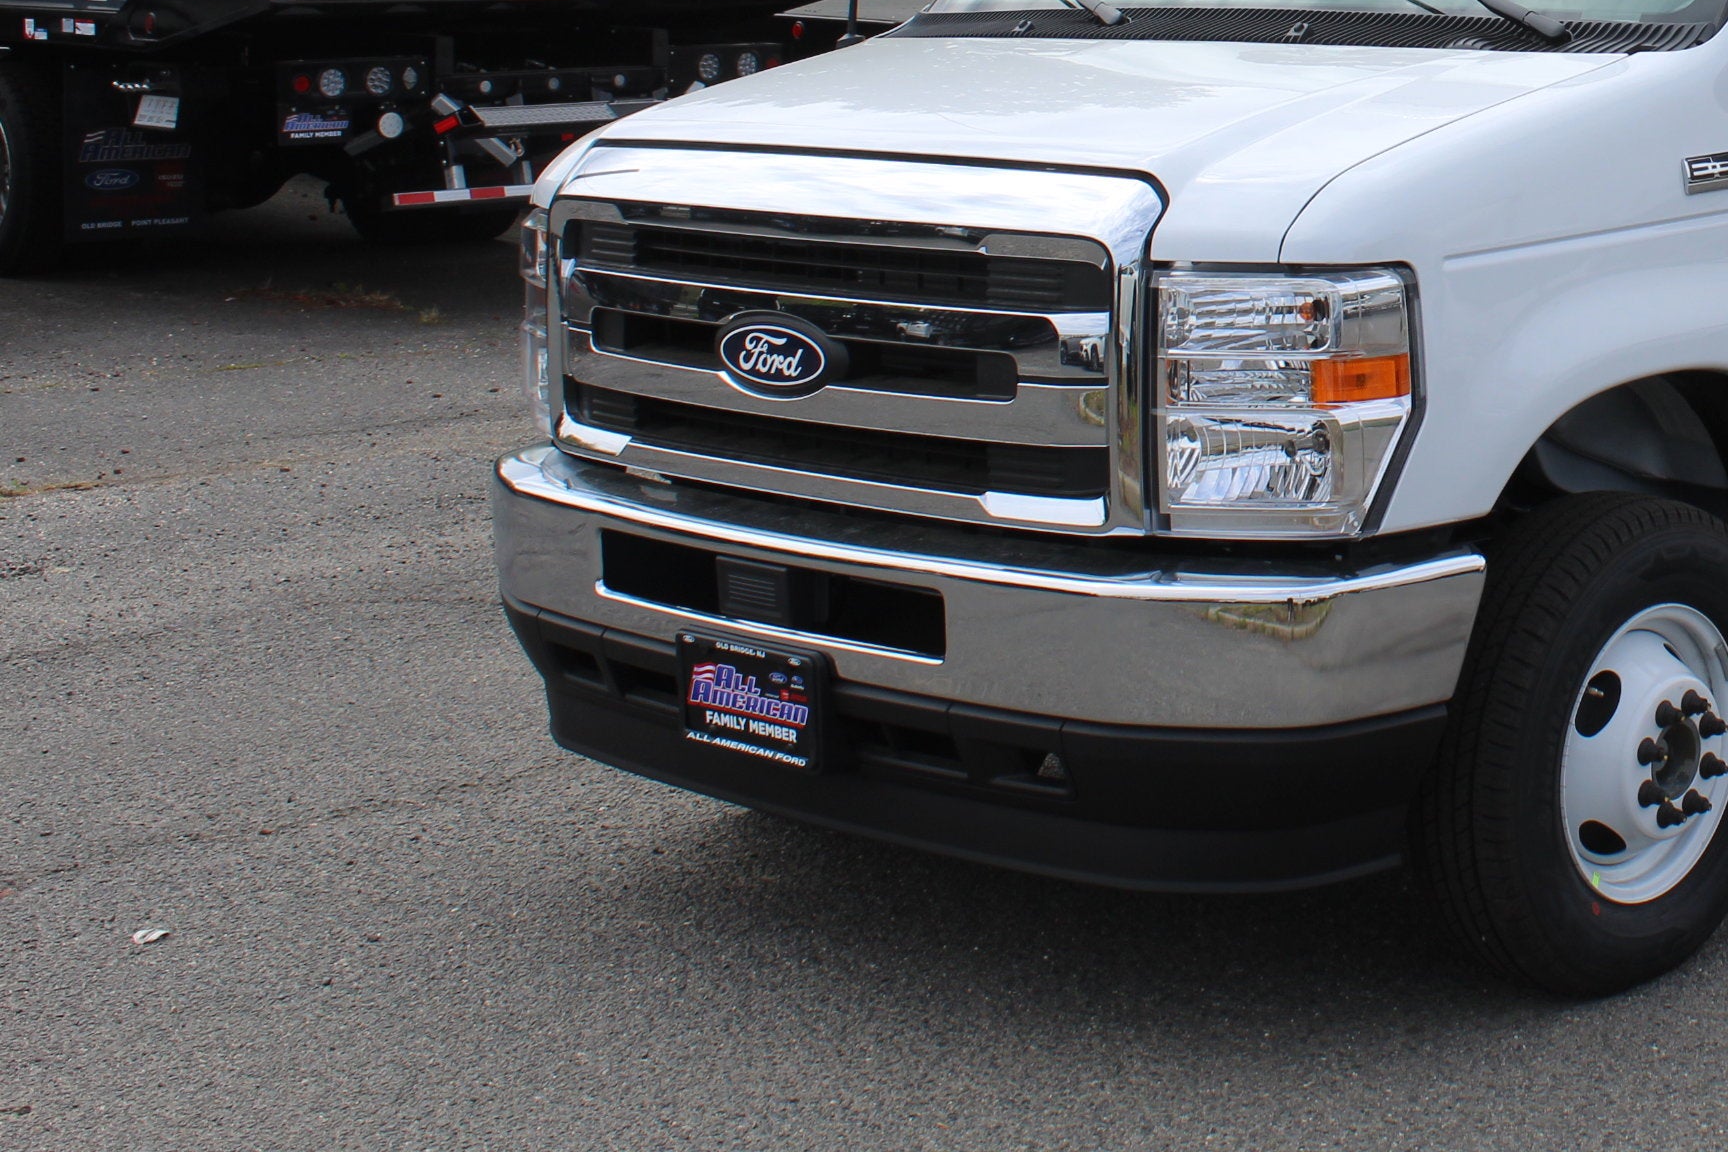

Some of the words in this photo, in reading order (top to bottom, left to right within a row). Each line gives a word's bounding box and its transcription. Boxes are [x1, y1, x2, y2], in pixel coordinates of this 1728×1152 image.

[94, 173, 129, 187] Ford
[739, 332, 804, 377] Ford
[716, 641, 728, 650] OLD
[714, 663, 761, 696] ALL
[690, 679, 809, 725] AMERICAN
[705, 710, 747, 731] FAMILY
[750, 719, 798, 744] MEMBER
[686, 731, 711, 743] ALL
[712, 736, 775, 758] AMERICAN
[775, 752, 807, 767] FORD
